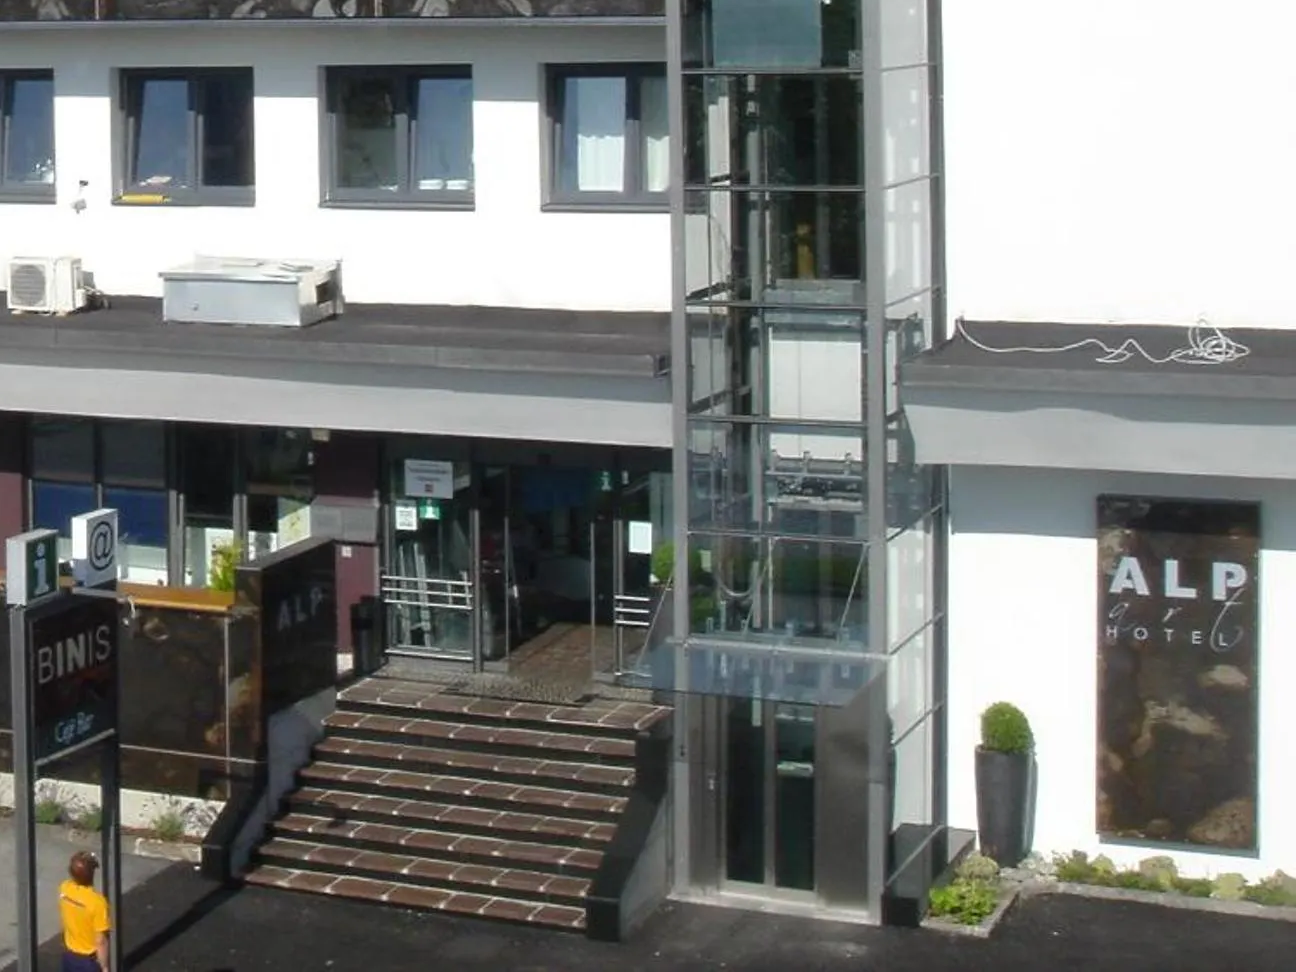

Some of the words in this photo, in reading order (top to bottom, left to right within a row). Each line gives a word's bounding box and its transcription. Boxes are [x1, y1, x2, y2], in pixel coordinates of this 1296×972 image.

[1108, 556, 1248, 601] ALP
[38, 625, 110, 684] BINIS
[1105, 625, 1229, 647] HOTEL
